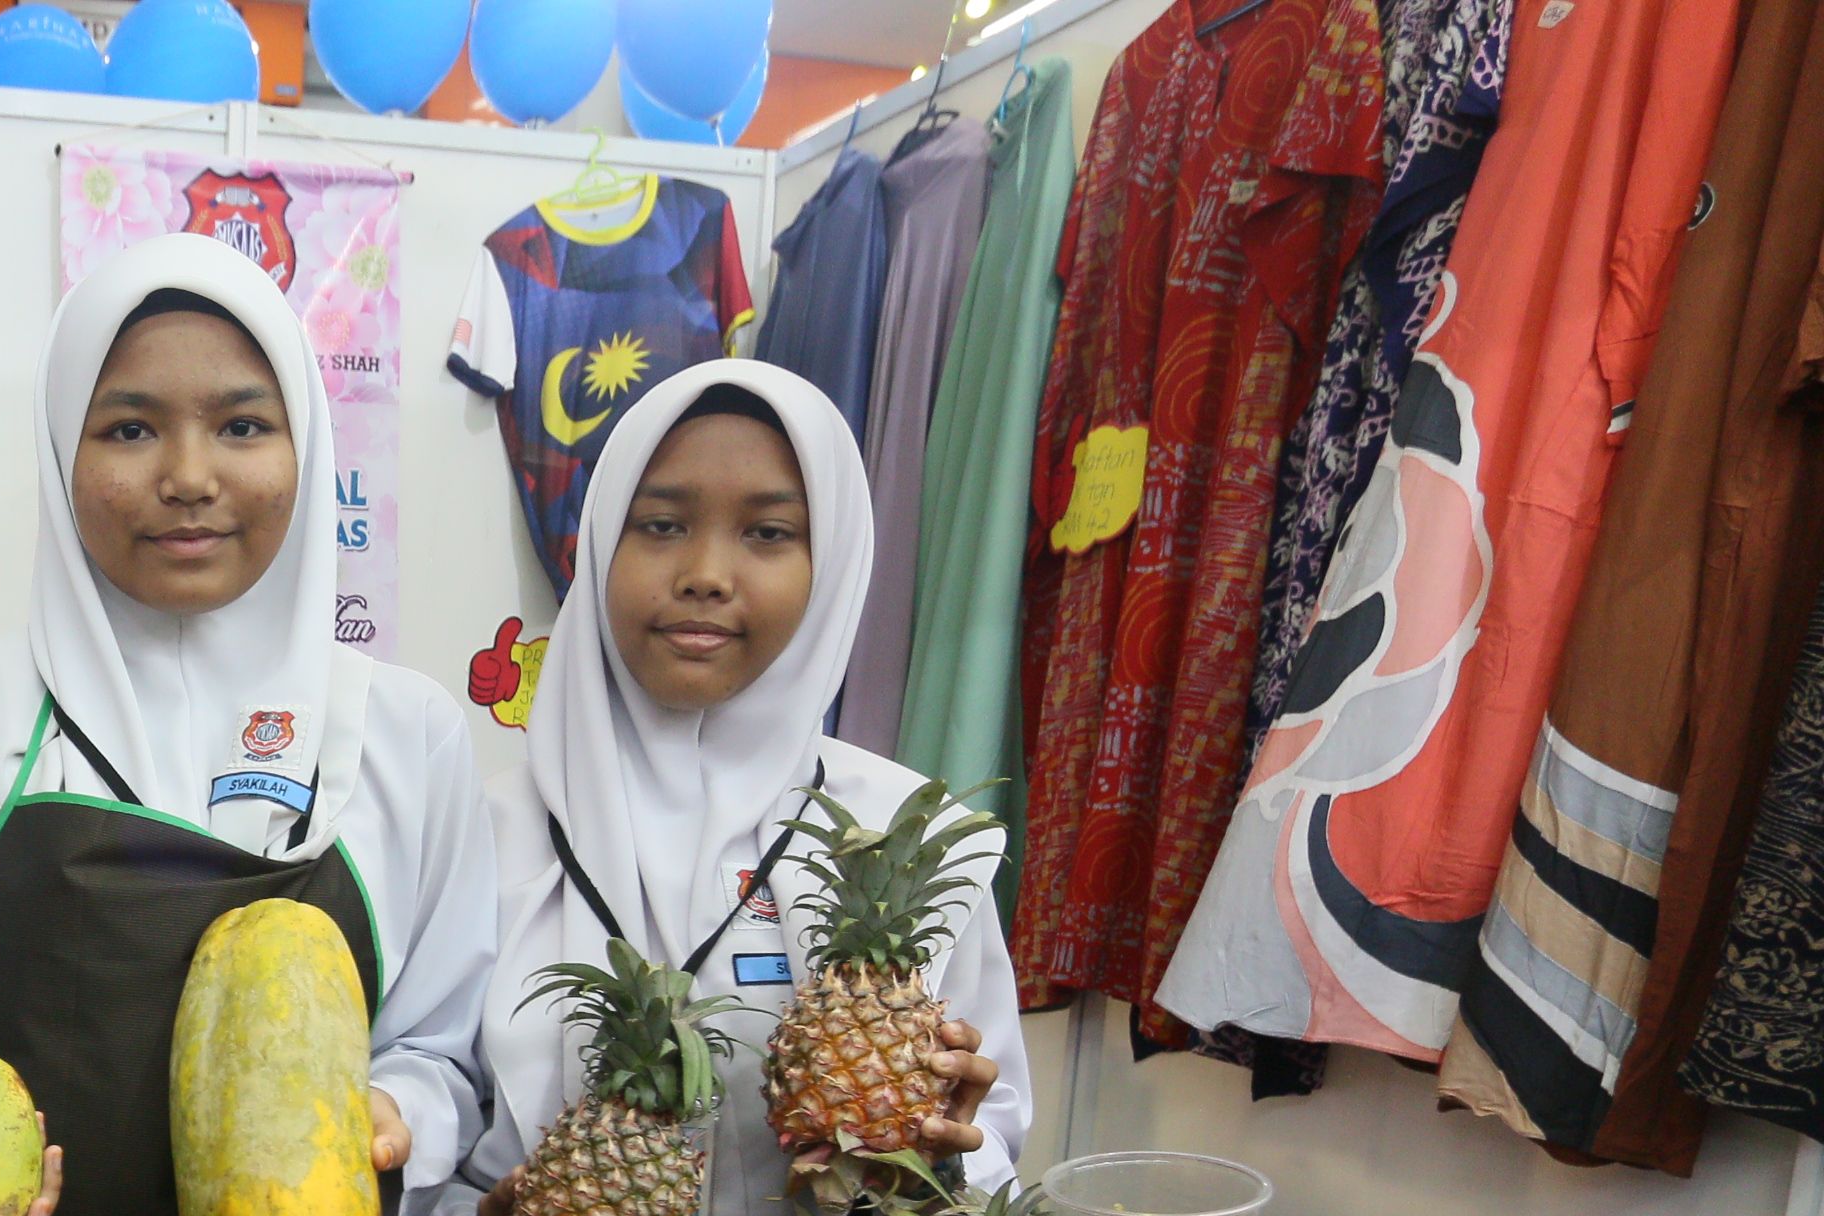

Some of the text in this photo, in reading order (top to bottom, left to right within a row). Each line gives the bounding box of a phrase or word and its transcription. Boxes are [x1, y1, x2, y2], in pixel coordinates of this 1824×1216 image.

[331, 354, 381, 373] SHAH
[336, 468, 369, 507] AL
[336, 517, 369, 549] AS
[228, 778, 288, 797] SYAKILAH
